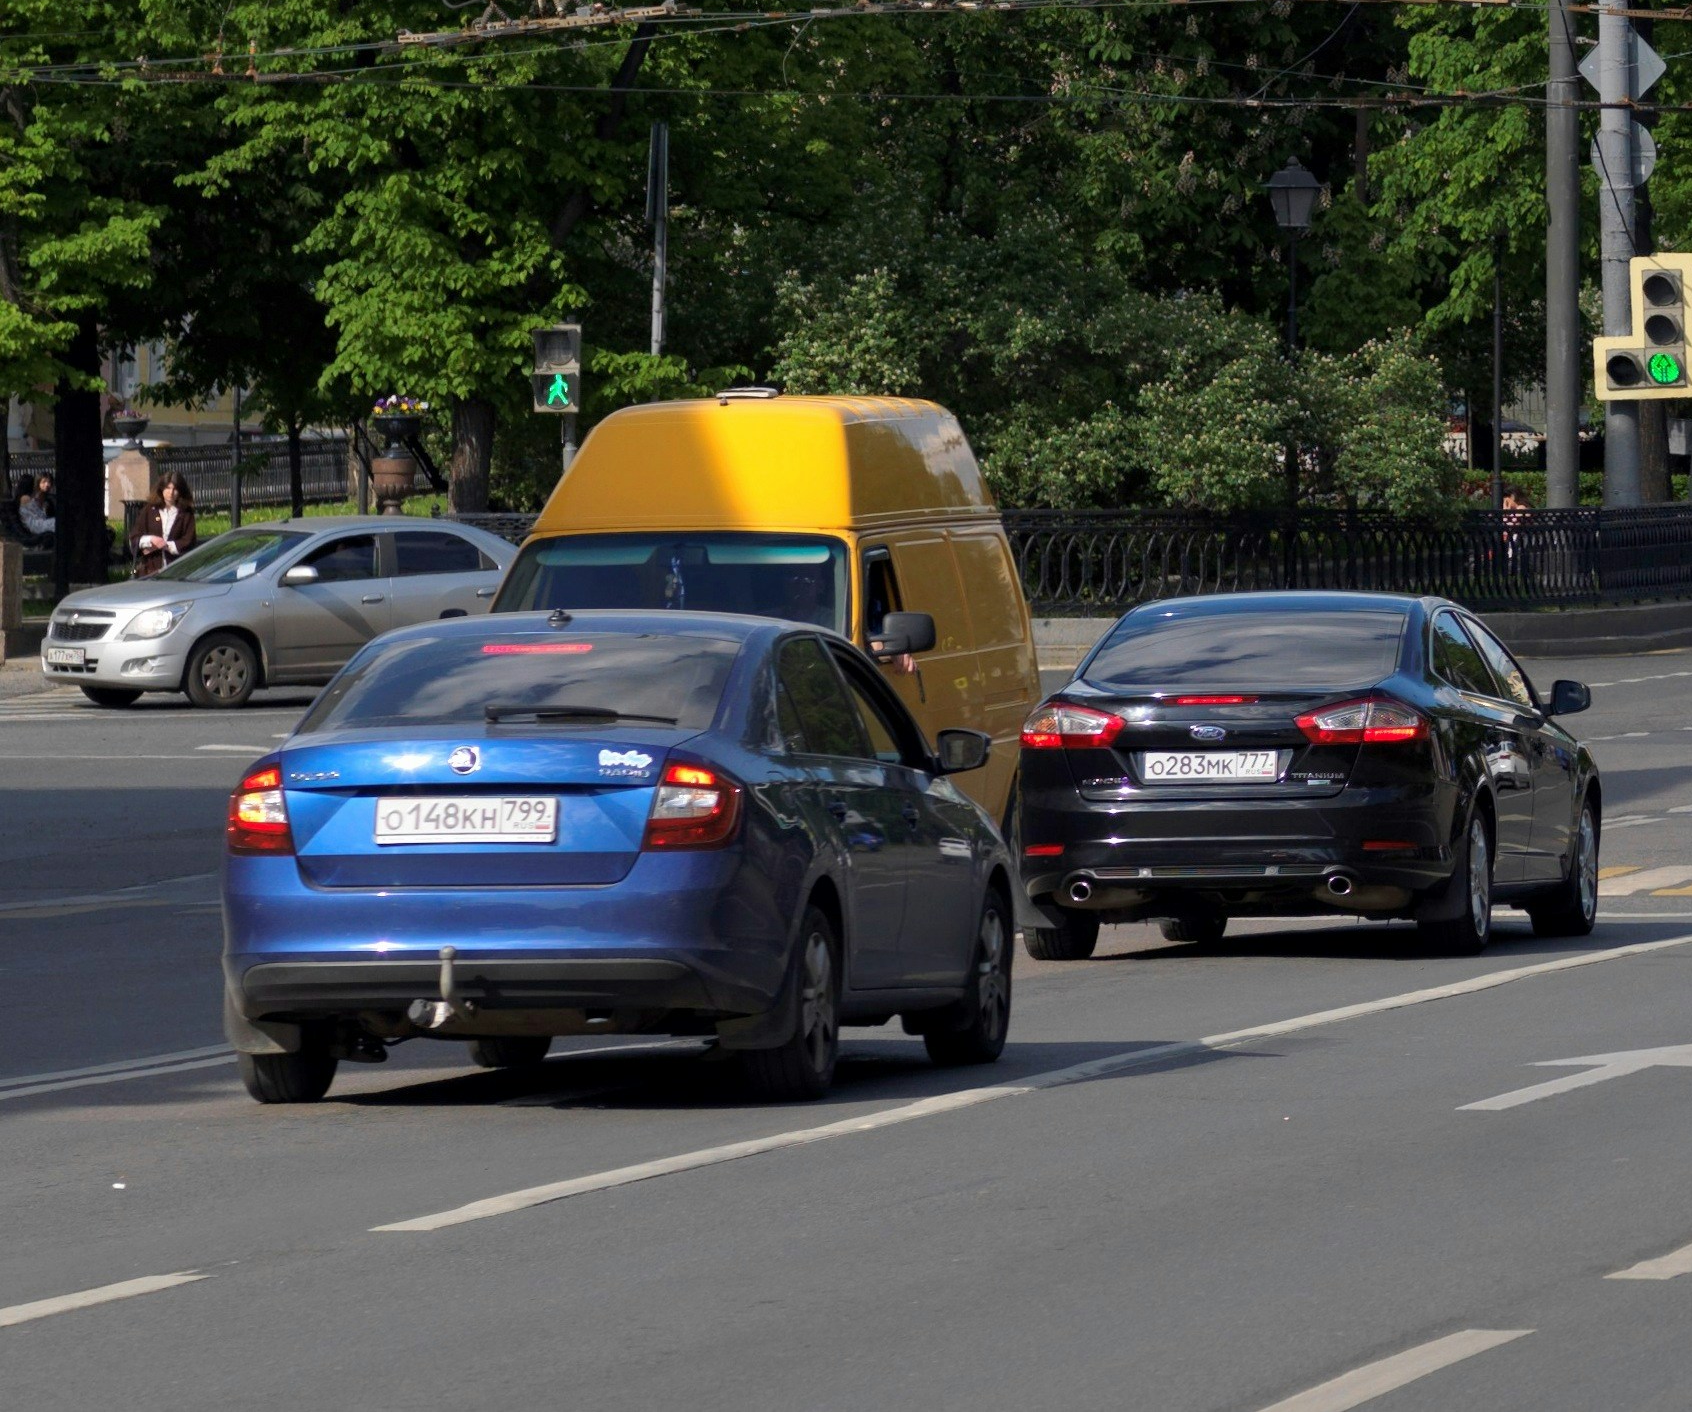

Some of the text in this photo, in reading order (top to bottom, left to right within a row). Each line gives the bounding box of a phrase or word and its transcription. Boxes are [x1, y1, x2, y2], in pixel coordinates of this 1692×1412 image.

[1151, 753, 1270, 776] О283МК 777
[386, 799, 548, 831] О148КН 799
[513, 821, 535, 830] RUS
